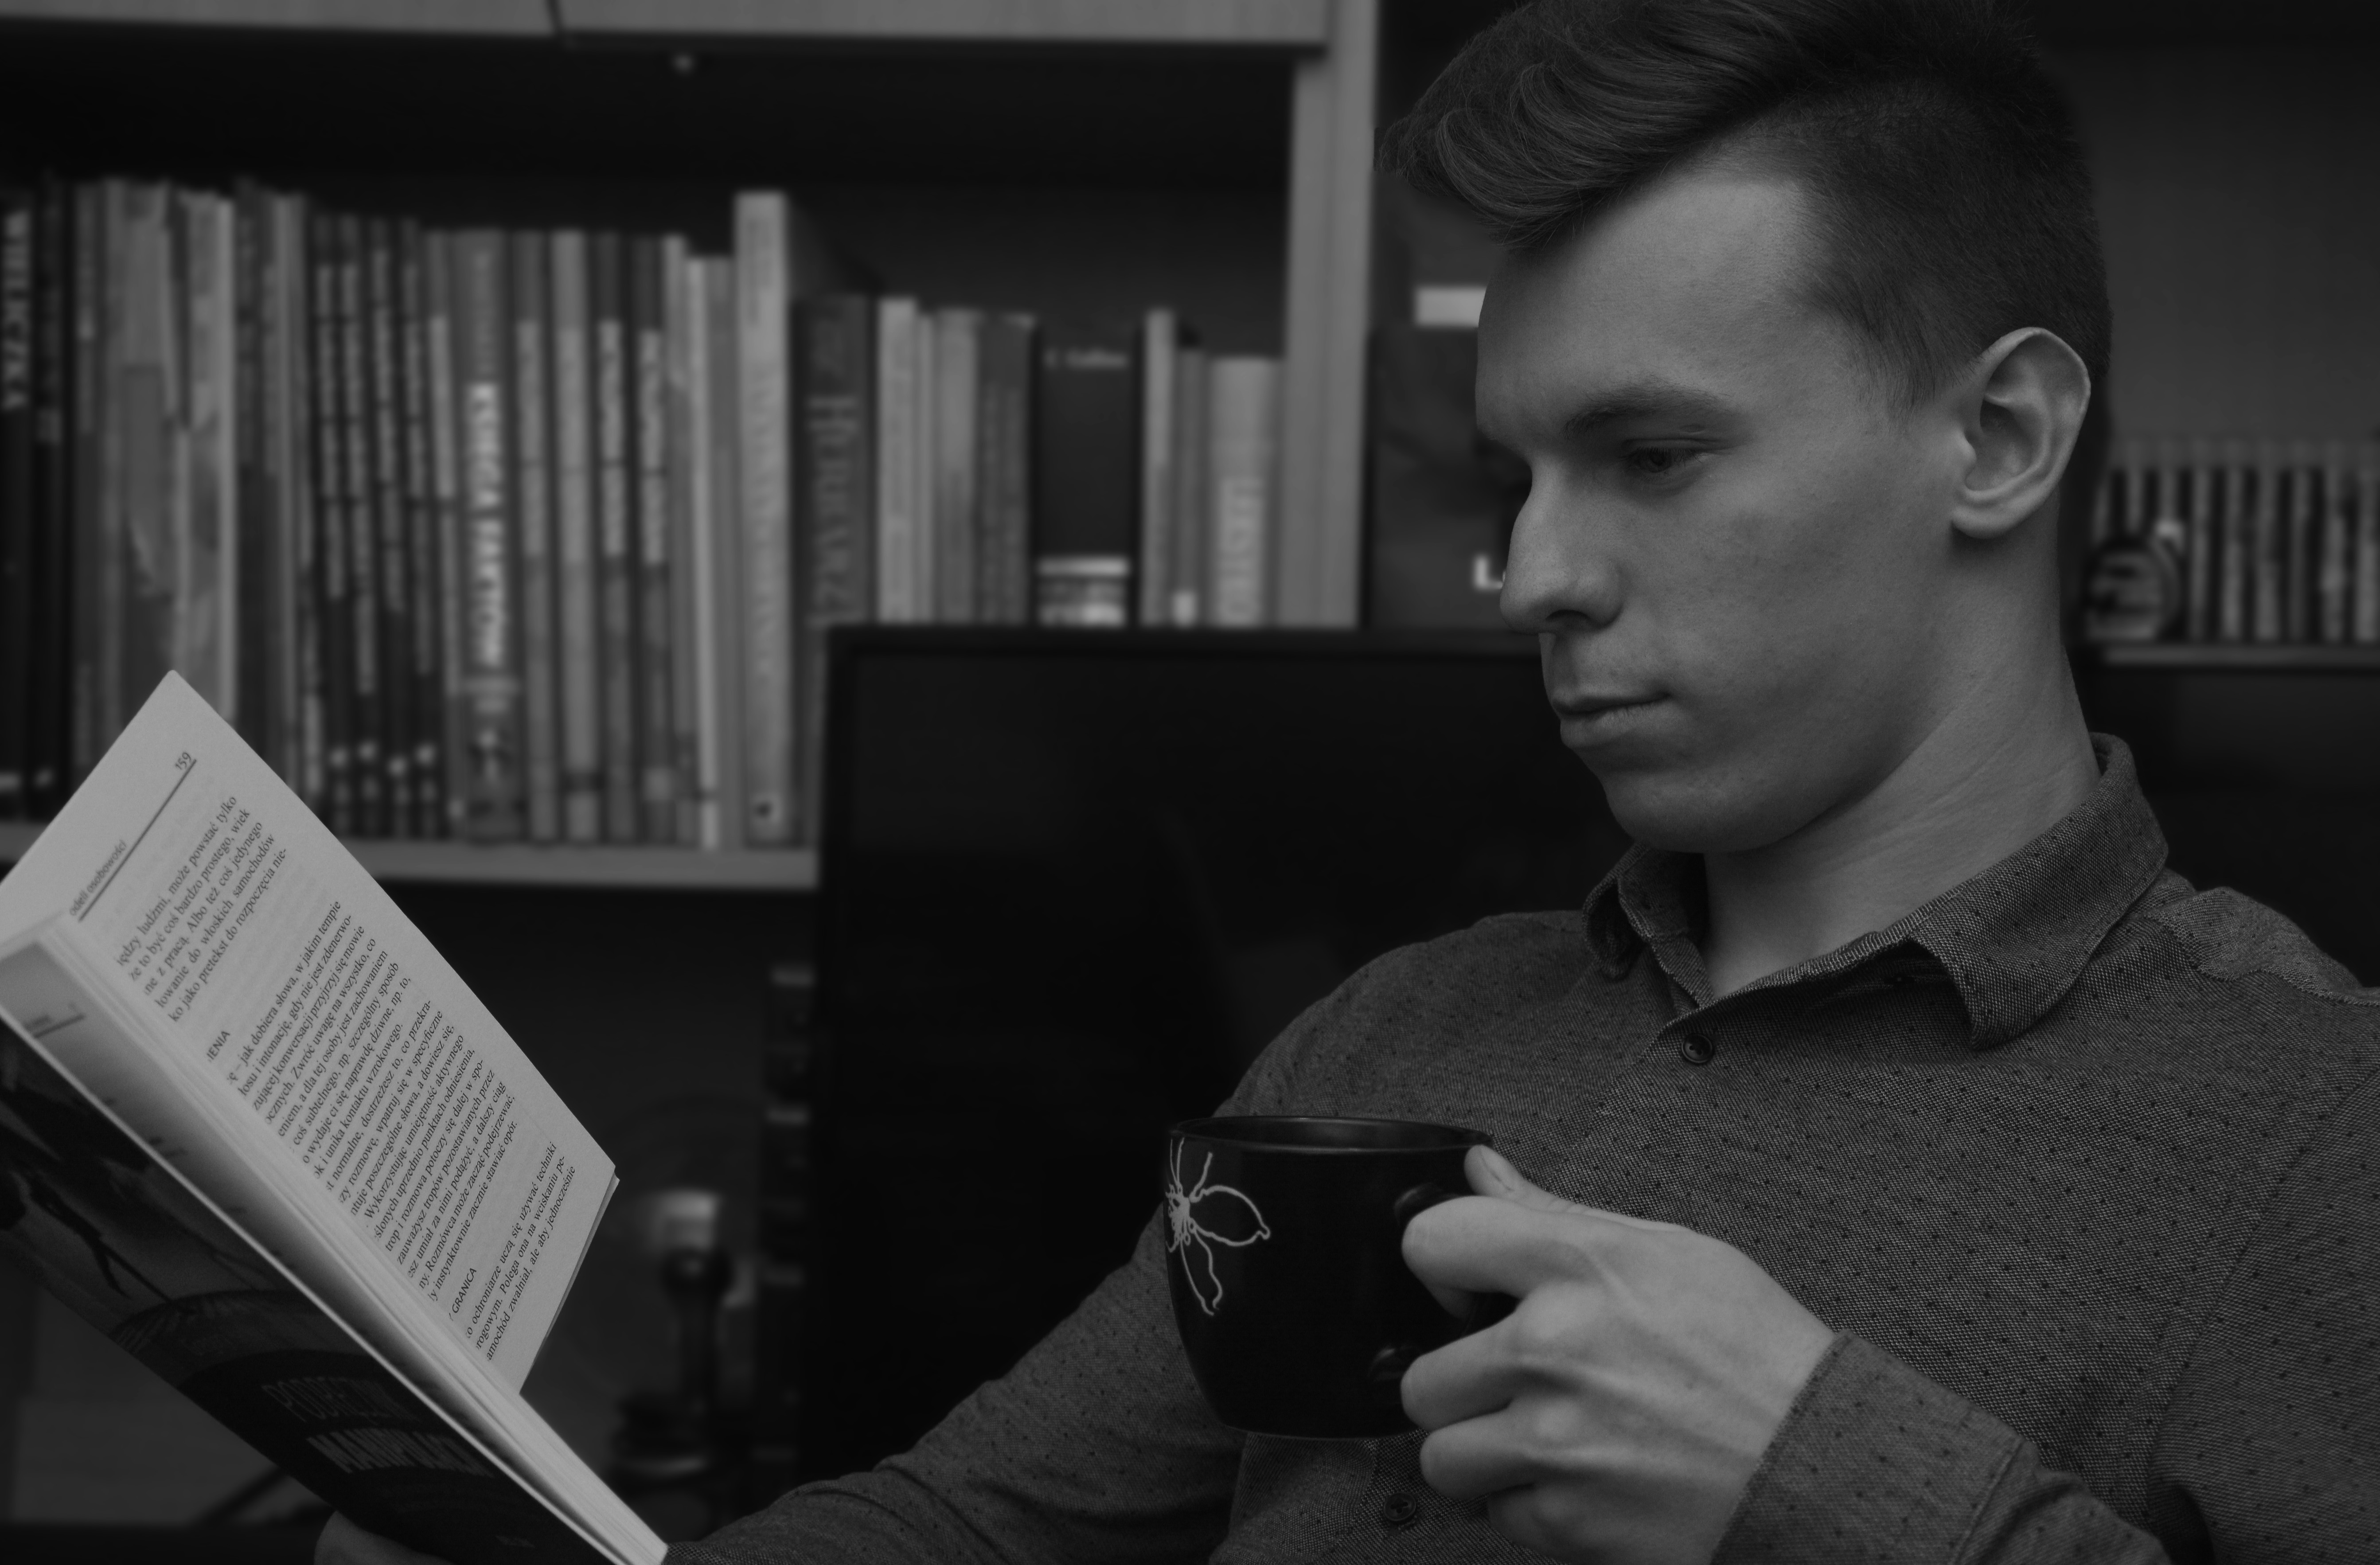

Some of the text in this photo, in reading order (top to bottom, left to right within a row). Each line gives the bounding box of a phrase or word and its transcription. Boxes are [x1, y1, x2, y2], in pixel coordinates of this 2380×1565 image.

[86, 839, 127, 894] osobowości
[173, 750, 192, 771] 159
[135, 895, 172, 936] ludźmi,
[168, 864, 191, 895] może
[187, 820, 219, 868] powstać
[215, 796, 237, 823] tylko
[137, 808, 251, 968] to być coś bardzo prostego, wiek
[156, 821, 263, 977] z pracą. Albo też coś jedynego
[178, 981, 201, 1011] jako
[198, 939, 229, 985] pretekst
[224, 925, 238, 941] do
[234, 867, 276, 927] rozpoczęcia
[272, 848, 287, 869] nie-
[187, 948, 201, 964] do
[199, 899, 234, 945] włoskich
[231, 833, 275, 899] samochodów
[320, 914, 352, 965] zdenerwo-
[237, 900, 341, 1067] jak dobiera słowa, w jakim tempie
[253, 925, 365, 1111] zującej konwersacji przyjrzyj się mowie
[255, 1020, 293, 1068] intonację,
[288, 996, 304, 1021] gdy
[289, 1042, 316, 1080] Zwróć
[312, 1011, 336, 1046] uwagę
[331, 998, 343, 1014] na
[338, 953, 370, 998] wszystko,
[366, 937, 376, 952] co
[300, 980, 313, 999] nie
[307, 961, 325, 987] jest
[336, 1012, 353, 1038] jest
[348, 950, 388, 1016] zachowaniem
[441, 1025, 455, 1042] się,
[205, 1030, 231, 1063] IENIA
[251, 1064, 262, 1074] i
[293, 962, 399, 1146] coś subtelnego, np. szczególny sposób
[298, 1093, 307, 1103] a
[302, 1076, 317, 1094] dla
[307, 977, 411, 1154] wydaje ci się naprawdę dziwne, np. to,
[312, 1059, 327, 1077] tej
[321, 1031, 343, 1063] osoby
[324, 1023, 403, 1159] unika kontaktu wzrokowego.
[332, 999, 431, 1181] normalne, dostrzeżesz to, co przekra-
[347, 1010, 443, 1186] rozmowę, wpatruj się w specyficzne
[399, 1091, 421, 1122] słowa,
[417, 1080, 425, 1090] a
[420, 1039, 445, 1081] dowiesz
[363, 1034, 464, 1219] Wykorzystując umiejętność aktywnego
[364, 1121, 403, 1191] poszczególne
[373, 1049, 476, 1239] ślonych uprzednio punktach odniesienia,
[384, 1059, 484, 1252] trop i rozmowa potoczy się dalej w spo-
[396, 1069, 495, 1265] zauważysz tropów pozostawianych przez
[415, 1080, 507, 1260] umiał za nimi podążyć, a dalszy ciąg
[424, 1093, 515, 1272] Rozmówca może zacząć podejrzewać,
[432, 1120, 518, 1290] instynktownie zacznie stawiać opór.
[471, 1140, 557, 1325] ochroniarze uczą się używać techniki
[475, 1155, 565, 1350] rogowym. Polega ona na wciskaniu pe-
[486, 1165, 576, 1361] amochód zwalniał, ale aby jednocześnie
[451, 1267, 477, 1314] GRANICA
